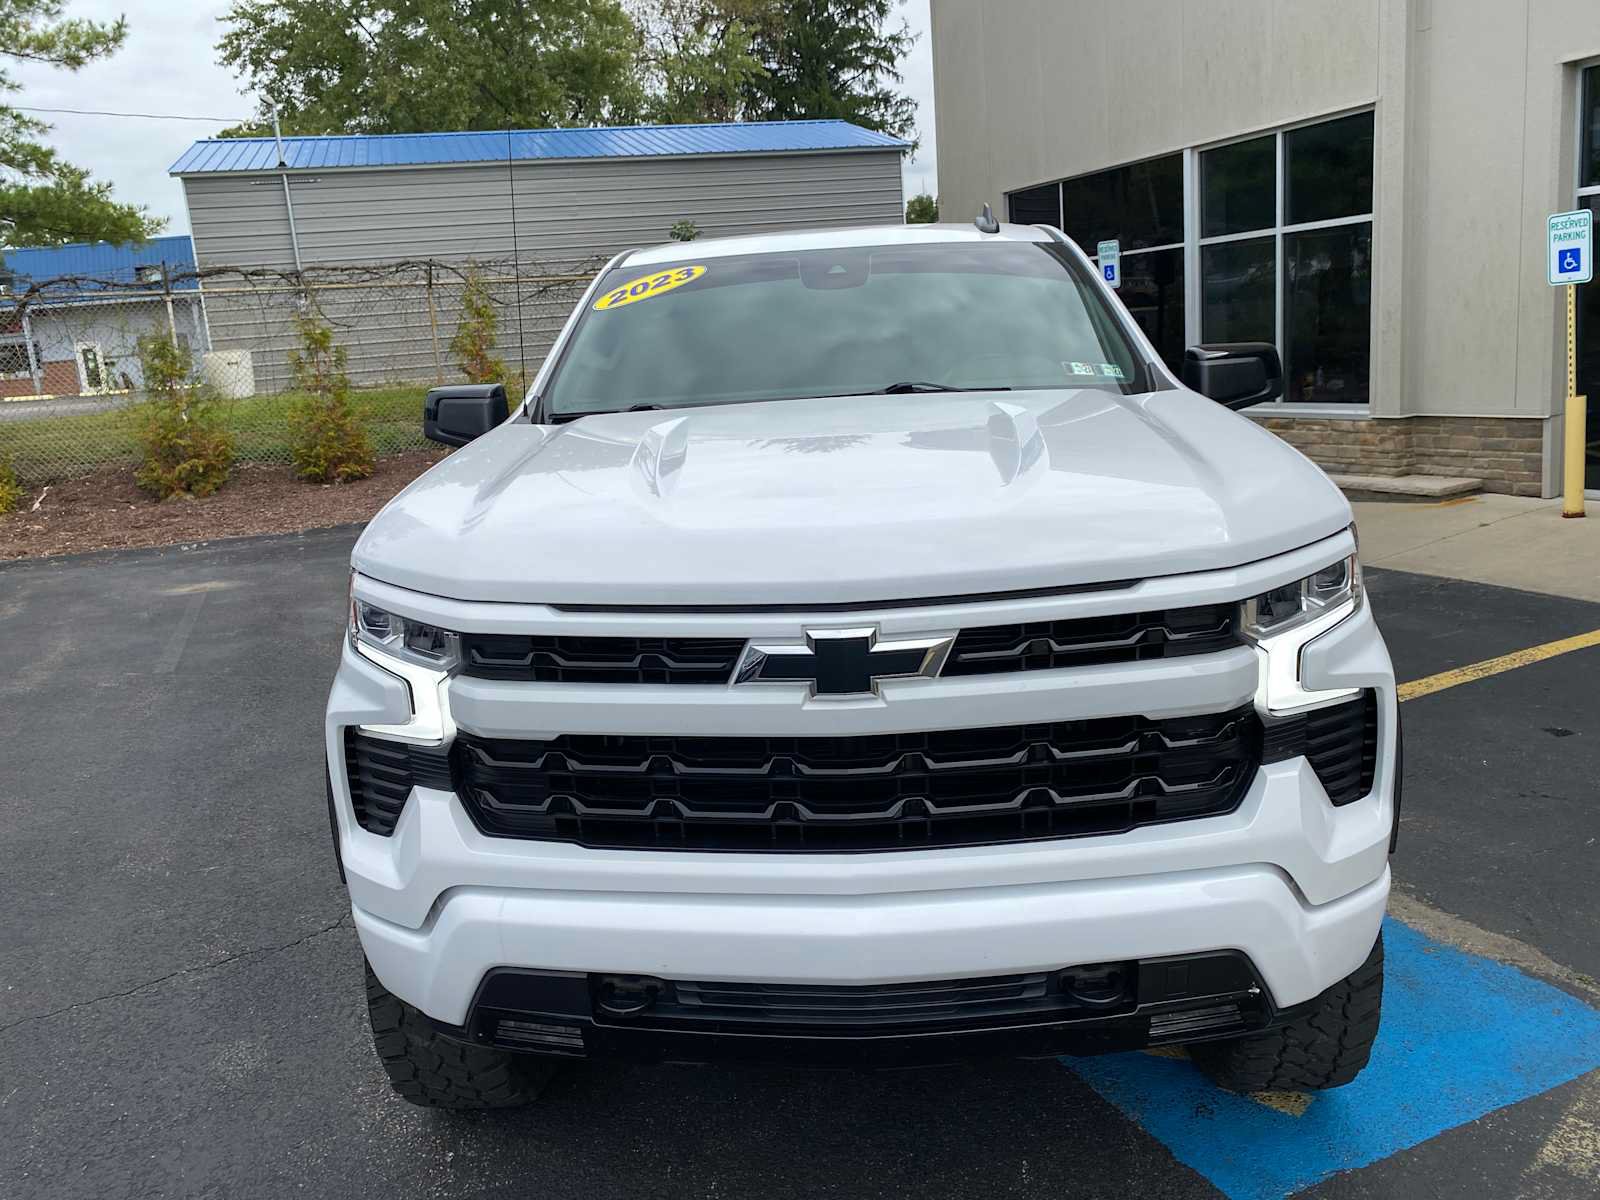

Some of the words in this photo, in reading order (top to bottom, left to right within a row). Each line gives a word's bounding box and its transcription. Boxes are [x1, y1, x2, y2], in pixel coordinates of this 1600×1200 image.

[1551, 217, 1588, 231] RESERVED
[1553, 231, 1586, 243] PARKING
[608, 267, 696, 306] 2023
